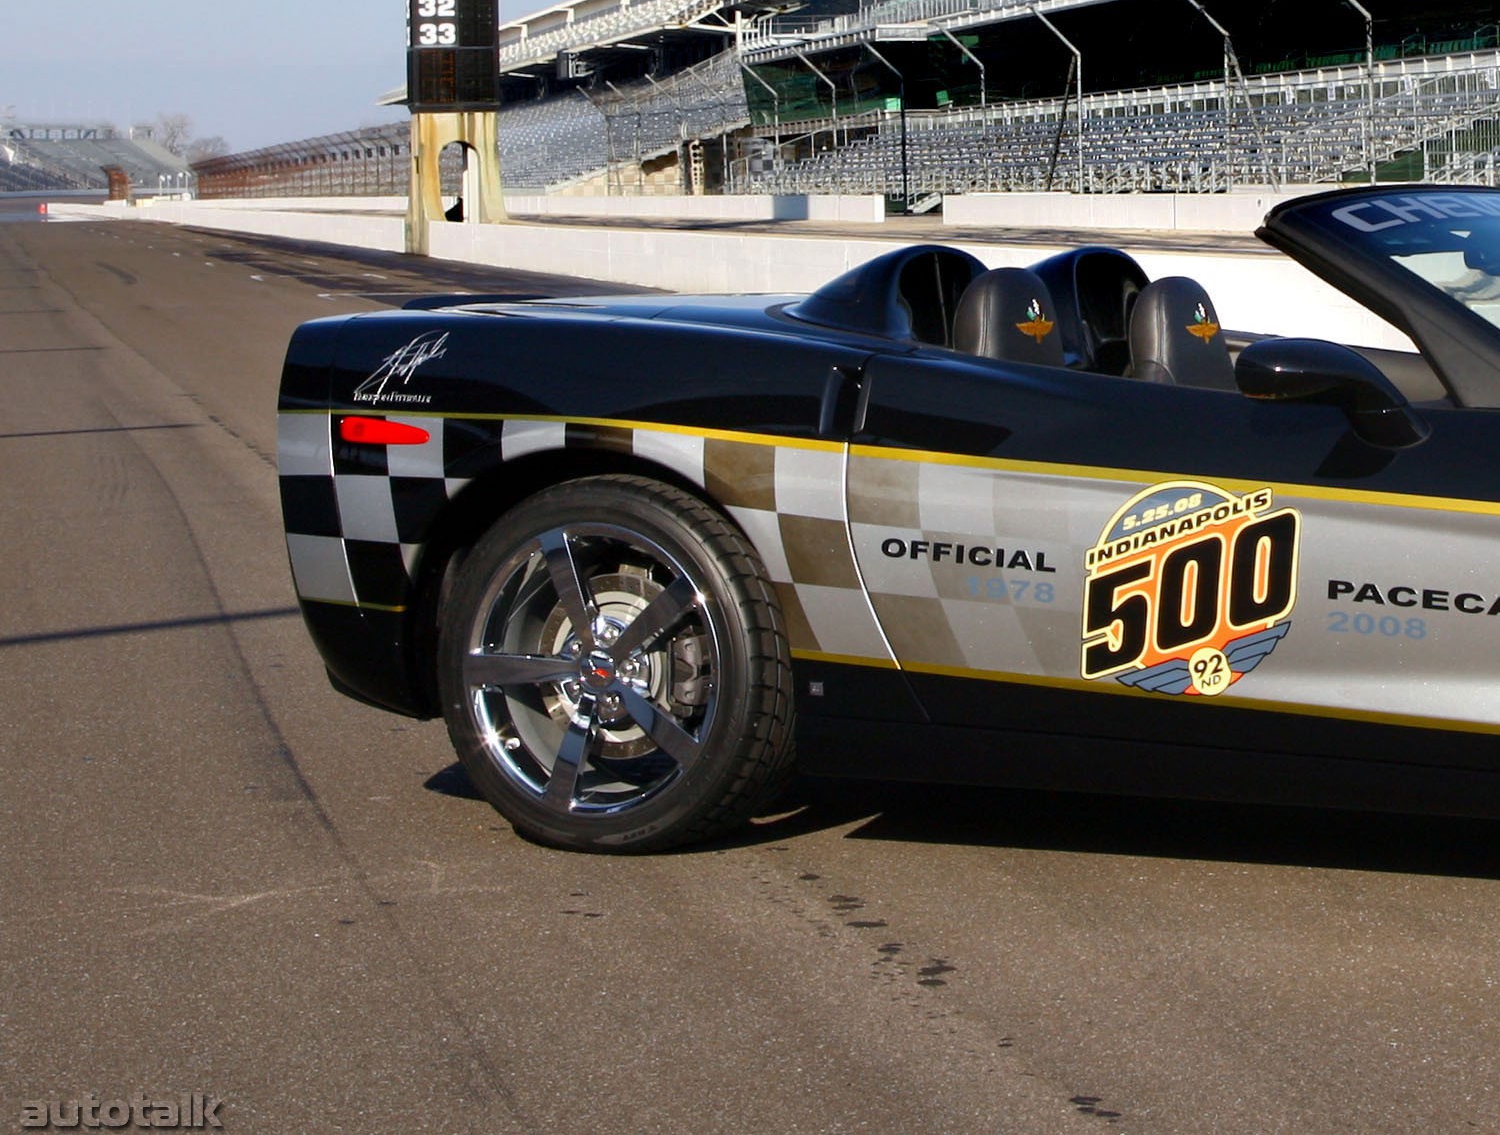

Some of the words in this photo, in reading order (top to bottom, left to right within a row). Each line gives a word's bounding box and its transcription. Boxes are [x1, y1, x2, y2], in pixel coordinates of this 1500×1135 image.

[418, 22, 456, 46] 33
[1121, 492, 1202, 531] 5.25.08
[1087, 490, 1269, 566] INDIANAPOLIS
[881, 538, 1057, 573] OFFICIAL
[965, 576, 1056, 603] 1978
[1085, 510, 1297, 676] 500
[1326, 610, 1428, 640] 2008
[1193, 653, 1223, 680] 92
[1200, 674, 1222, 689] ND
